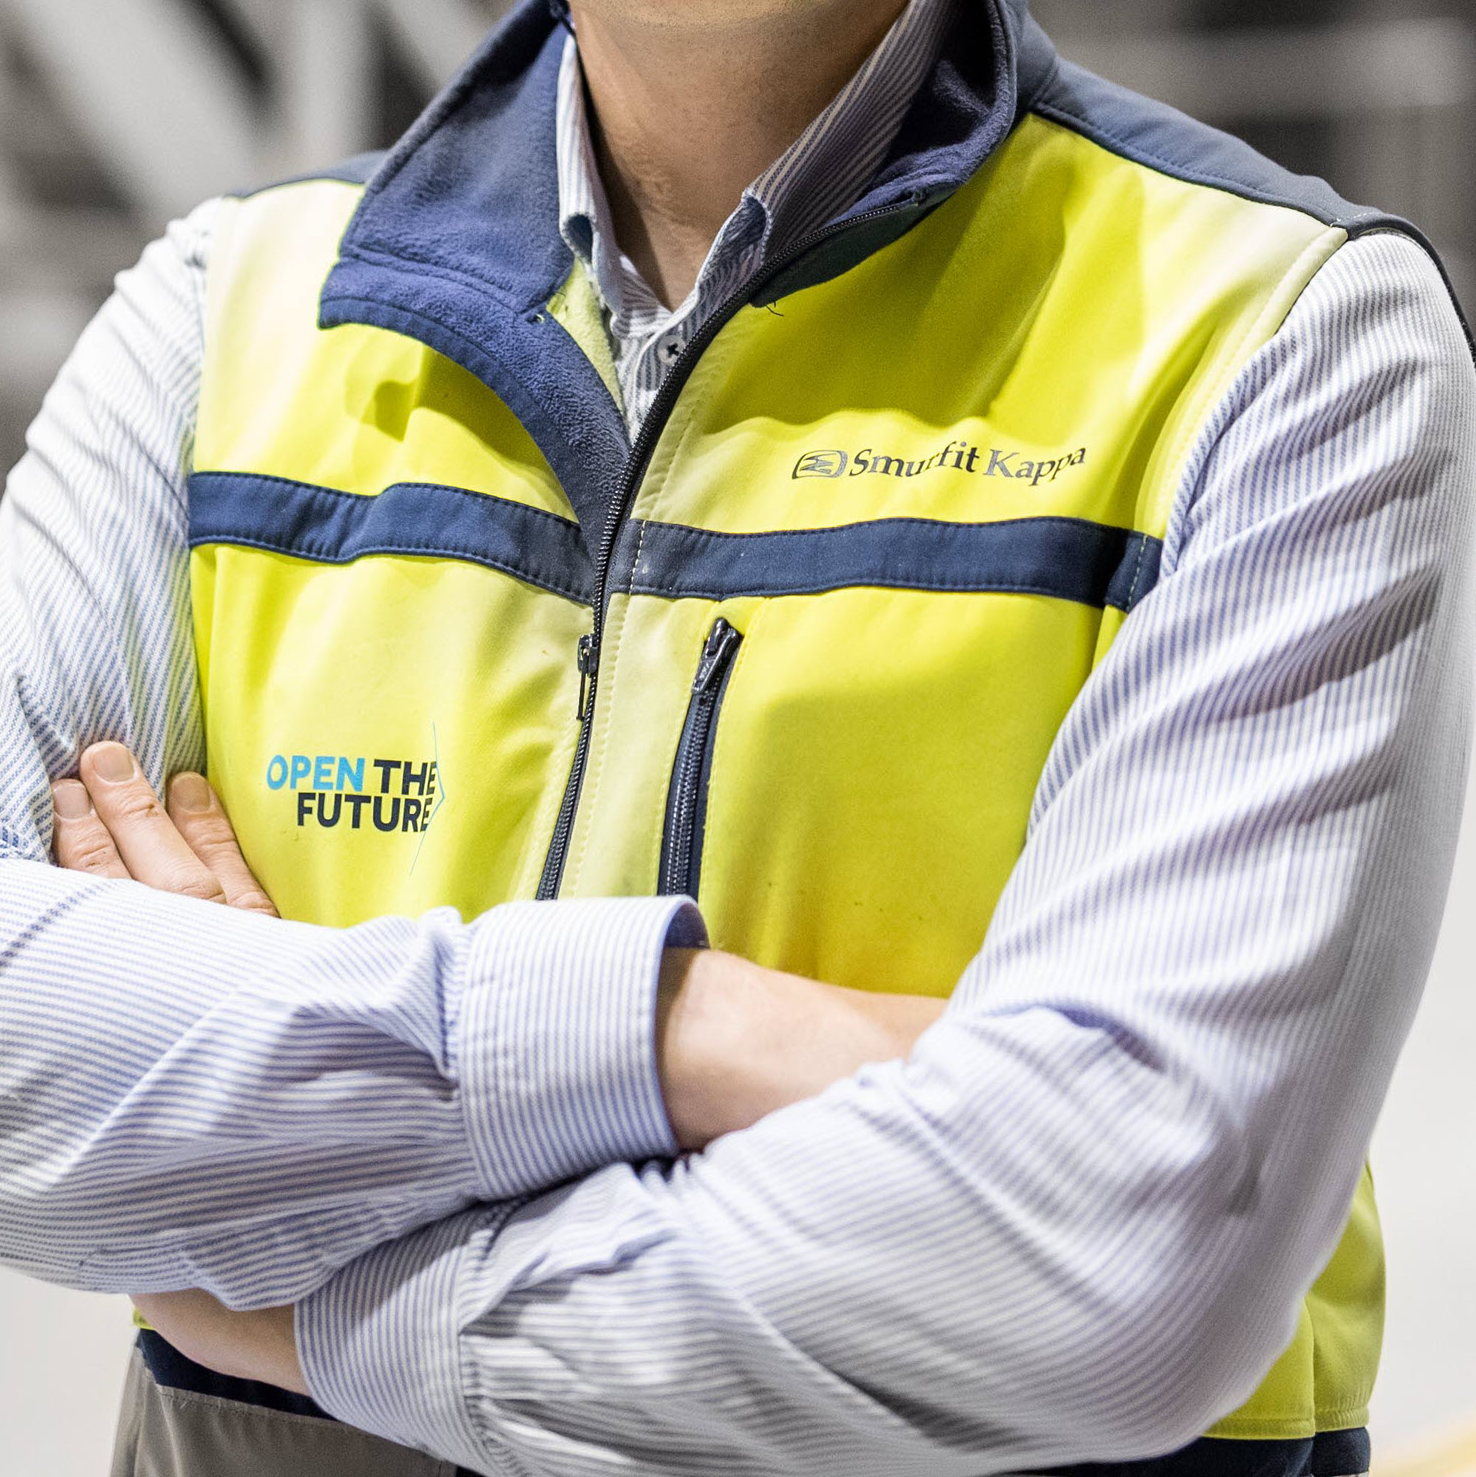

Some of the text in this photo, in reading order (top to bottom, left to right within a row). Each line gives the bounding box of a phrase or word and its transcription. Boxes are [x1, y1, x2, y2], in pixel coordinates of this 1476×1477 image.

[848, 441, 1086, 486] Smurfit Kappa
[266, 754, 437, 796] OPEN THE
[297, 792, 433, 832] FUTURE
